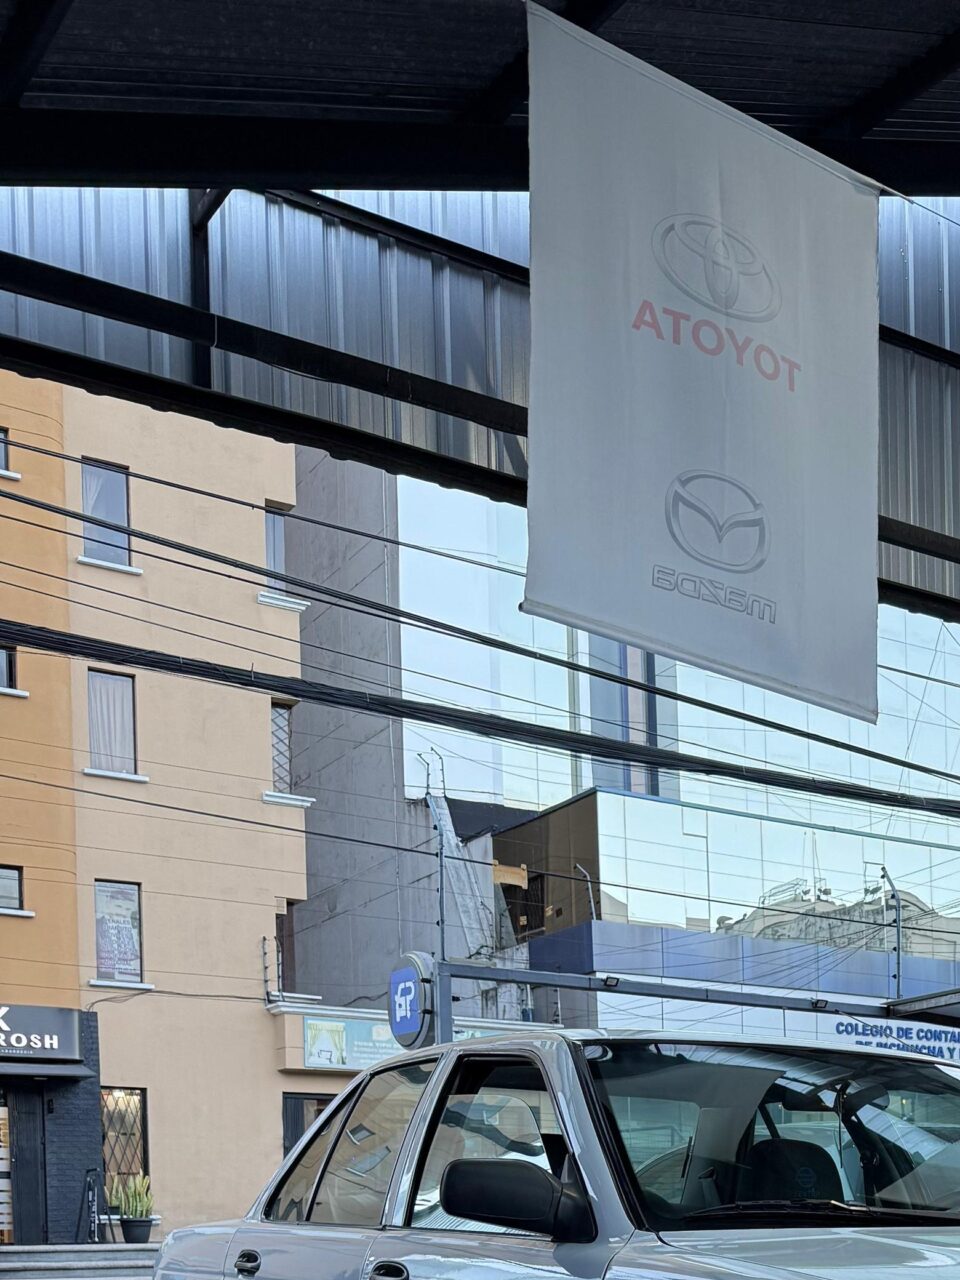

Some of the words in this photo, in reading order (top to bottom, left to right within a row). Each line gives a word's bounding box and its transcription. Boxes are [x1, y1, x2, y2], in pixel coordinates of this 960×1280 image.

[836, 1022, 893, 1038] COLEGIO
[897, 1027, 913, 1040] DE
[947, 1046, 956, 1060] Y
